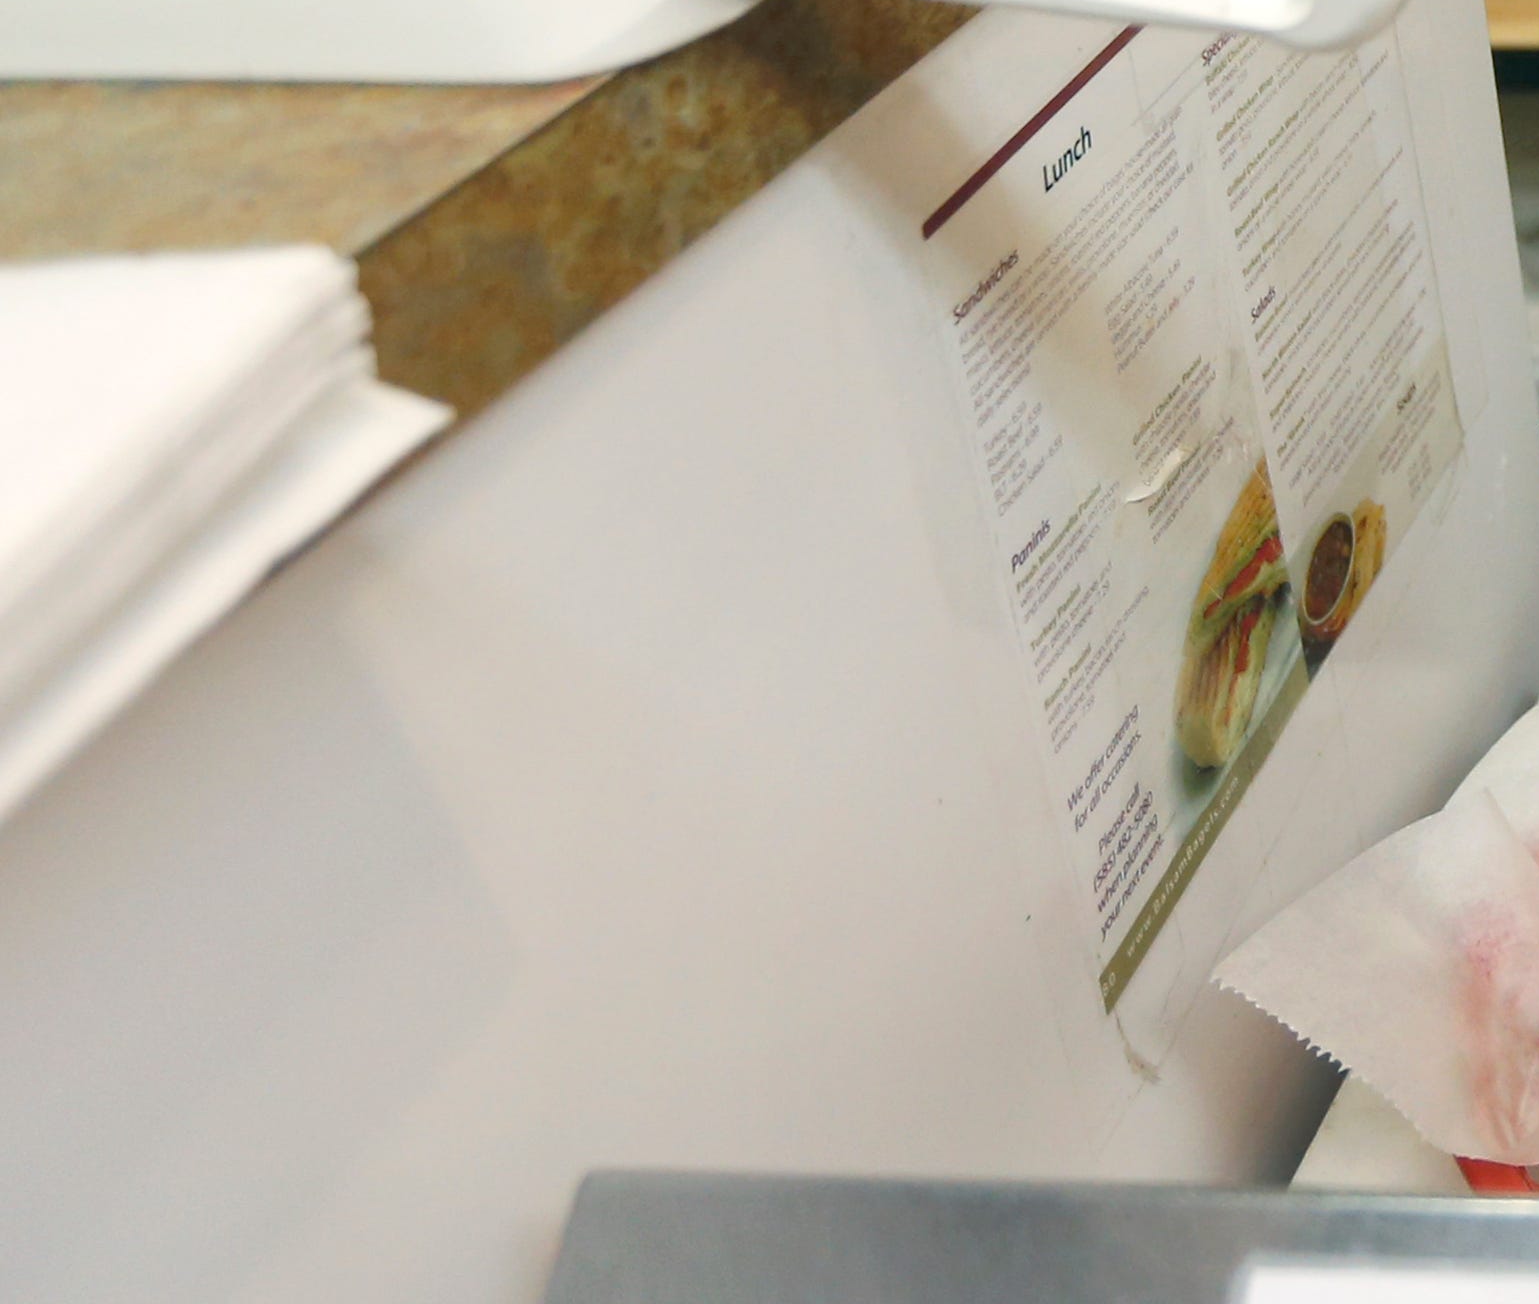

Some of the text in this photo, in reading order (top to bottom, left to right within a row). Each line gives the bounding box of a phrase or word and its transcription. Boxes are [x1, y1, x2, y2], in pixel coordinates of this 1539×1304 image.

[1040, 119, 1092, 193] Lunch
[951, 242, 1020, 328] Sandwiches
[1009, 512, 1051, 575] Paninis
[1067, 702, 1139, 814] We offer catering
[1097, 780, 1141, 857] Please call
